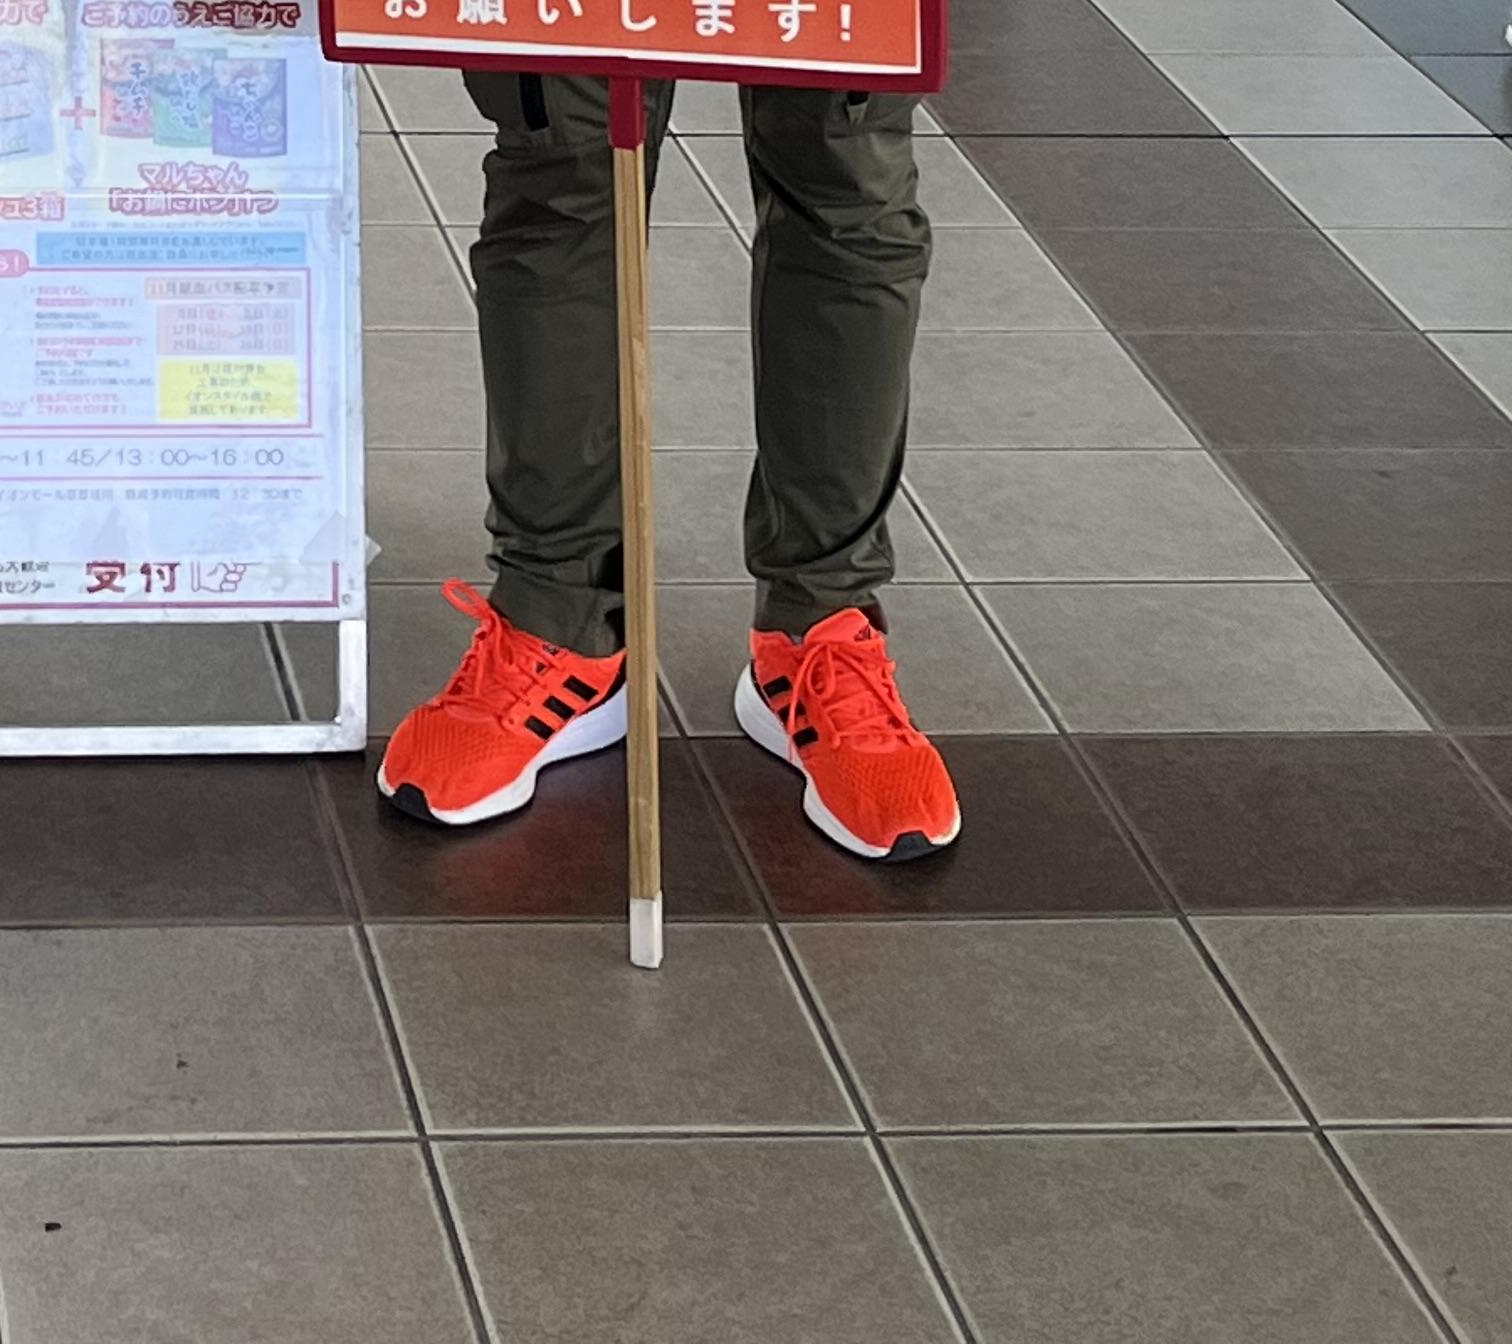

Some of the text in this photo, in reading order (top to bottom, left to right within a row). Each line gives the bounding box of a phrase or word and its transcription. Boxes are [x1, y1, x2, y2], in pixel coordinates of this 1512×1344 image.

[82, 0, 302, 30] ご予約のうえご協力で
